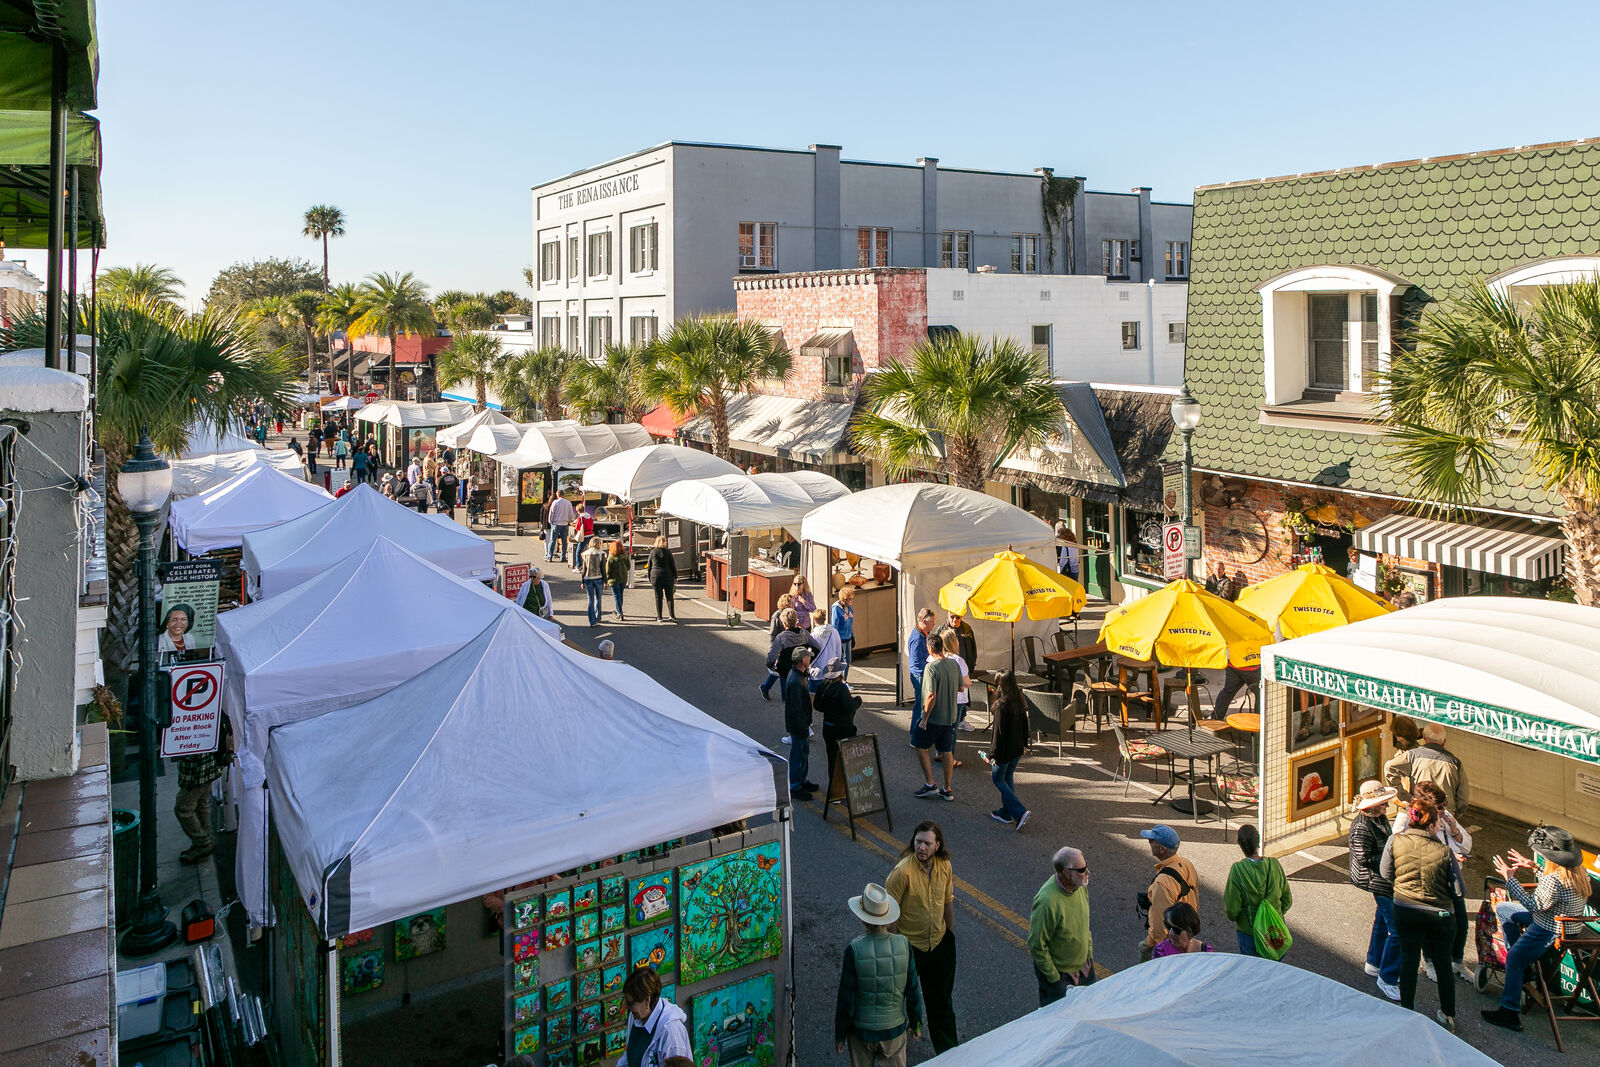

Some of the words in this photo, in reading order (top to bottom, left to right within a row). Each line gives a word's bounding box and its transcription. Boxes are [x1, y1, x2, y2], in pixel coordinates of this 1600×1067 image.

[558, 192, 574, 210] THE
[577, 174, 639, 205] RENAISSANCE
[169, 568, 216, 576] CELEBRATES
[506, 568, 527, 577] SALE
[506, 575, 526, 584] SALE
[506, 583, 520, 591] SAL
[1026, 588, 1045, 596] TWISTED
[1322, 608, 1334, 616] TEA
[1199, 629, 1211, 637] TEA
[1279, 660, 1348, 693] LAUREN
[1354, 679, 1436, 715] GRAHAM
[1446, 700, 1600, 757] CUNNINGHAM
[182, 712, 215, 723] PARKING
[170, 725, 191, 733] Entire
